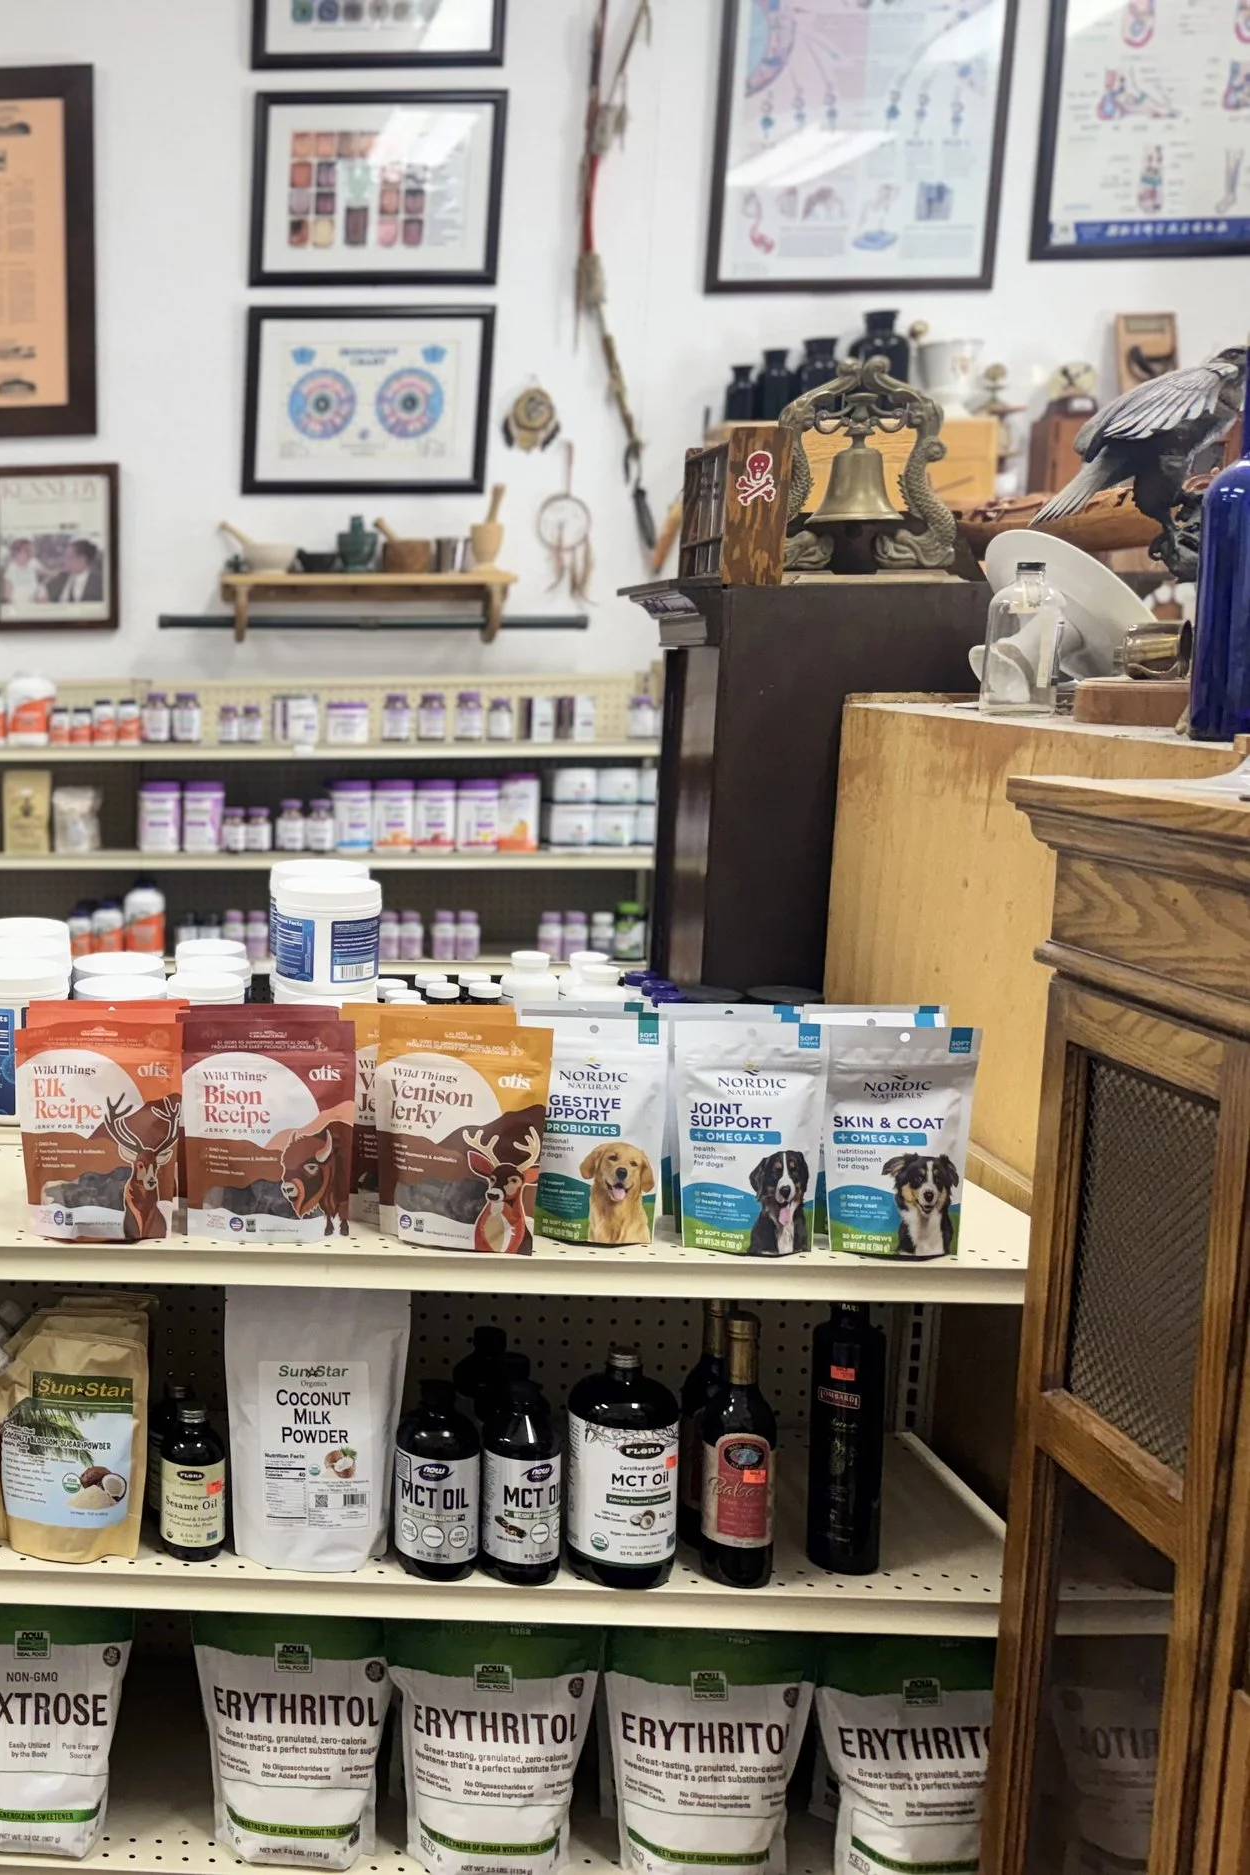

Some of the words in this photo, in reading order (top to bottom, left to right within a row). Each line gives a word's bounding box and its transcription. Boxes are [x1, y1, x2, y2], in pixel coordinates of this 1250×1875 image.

[34, 1065, 57, 1075] Wild
[59, 1065, 96, 1076] Things
[203, 1072, 228, 1080] Wild
[230, 1072, 267, 1082] Things
[309, 1065, 342, 1081] otis
[393, 1067, 418, 1078] Wild
[421, 1070, 458, 1084] Things
[559, 1070, 628, 1083] NORDIC
[33, 1078, 66, 1098] Elk
[498, 1072, 532, 1090] otis
[718, 1077, 786, 1089] NORDIC
[863, 1081, 932, 1092] NORDIC
[204, 1084, 262, 1104] Bison
[391, 1079, 473, 1108] Venison
[549, 1095, 621, 1109] GESTIVE
[690, 1102, 742, 1115] JOINT
[35, 1098, 101, 1124] Recipe
[204, 1105, 270, 1128] Recipe
[545, 1107, 610, 1121] UPPORT
[546, 1123, 617, 1135] PROBIOTICS
[691, 1115, 772, 1129] SUPPORT
[833, 1116, 874, 1128] SKIN
[880, 1117, 890, 1128] &
[897, 1118, 944, 1130] COAT
[694, 1153, 736, 1161] supplement
[279, 1365, 308, 1377] Sun
[316, 1365, 348, 1377] Star
[38, 1379, 75, 1395] Sun
[85, 1383, 130, 1397] Star
[276, 1389, 351, 1406] COCONUT
[294, 1408, 331, 1425] MILK
[4, 1432, 29, 1441] COCONUT
[31, 1436, 58, 1445] BLOSSOM
[84, 1442, 111, 1450] POWDER
[282, 1427, 348, 1443] POWDER
[626, 1447, 661, 1455] FLORA
[612, 1473, 647, 1486] MCT
[653, 1471, 669, 1485] Oil
[166, 1495, 198, 1510] Sesame
[202, 1499, 217, 1510] Oil
[402, 1482, 437, 1509] MCT
[443, 1488, 469, 1510] OIL
[503, 1485, 544, 1509] MCT
[6, 1672, 58, 1682] NON-GMO
[214, 1685, 379, 1727] ERYTHRITOL
[225, 1726, 274, 1744] Great-tasting,
[276, 1735, 319, 1745] granulated,
[320, 1736, 367, 1745] zero-calorie
[78, 1743, 99, 1751] Energy
[279, 1745, 307, 1754] perfect
[309, 1746, 346, 1756] substitute
[348, 1747, 358, 1755] for
[278, 1771, 297, 1779] Added
[482, 1764, 512, 1773] perfect
[512, 1764, 549, 1773] substitute
[37, 1811, 74, 1821] SWEETENER
